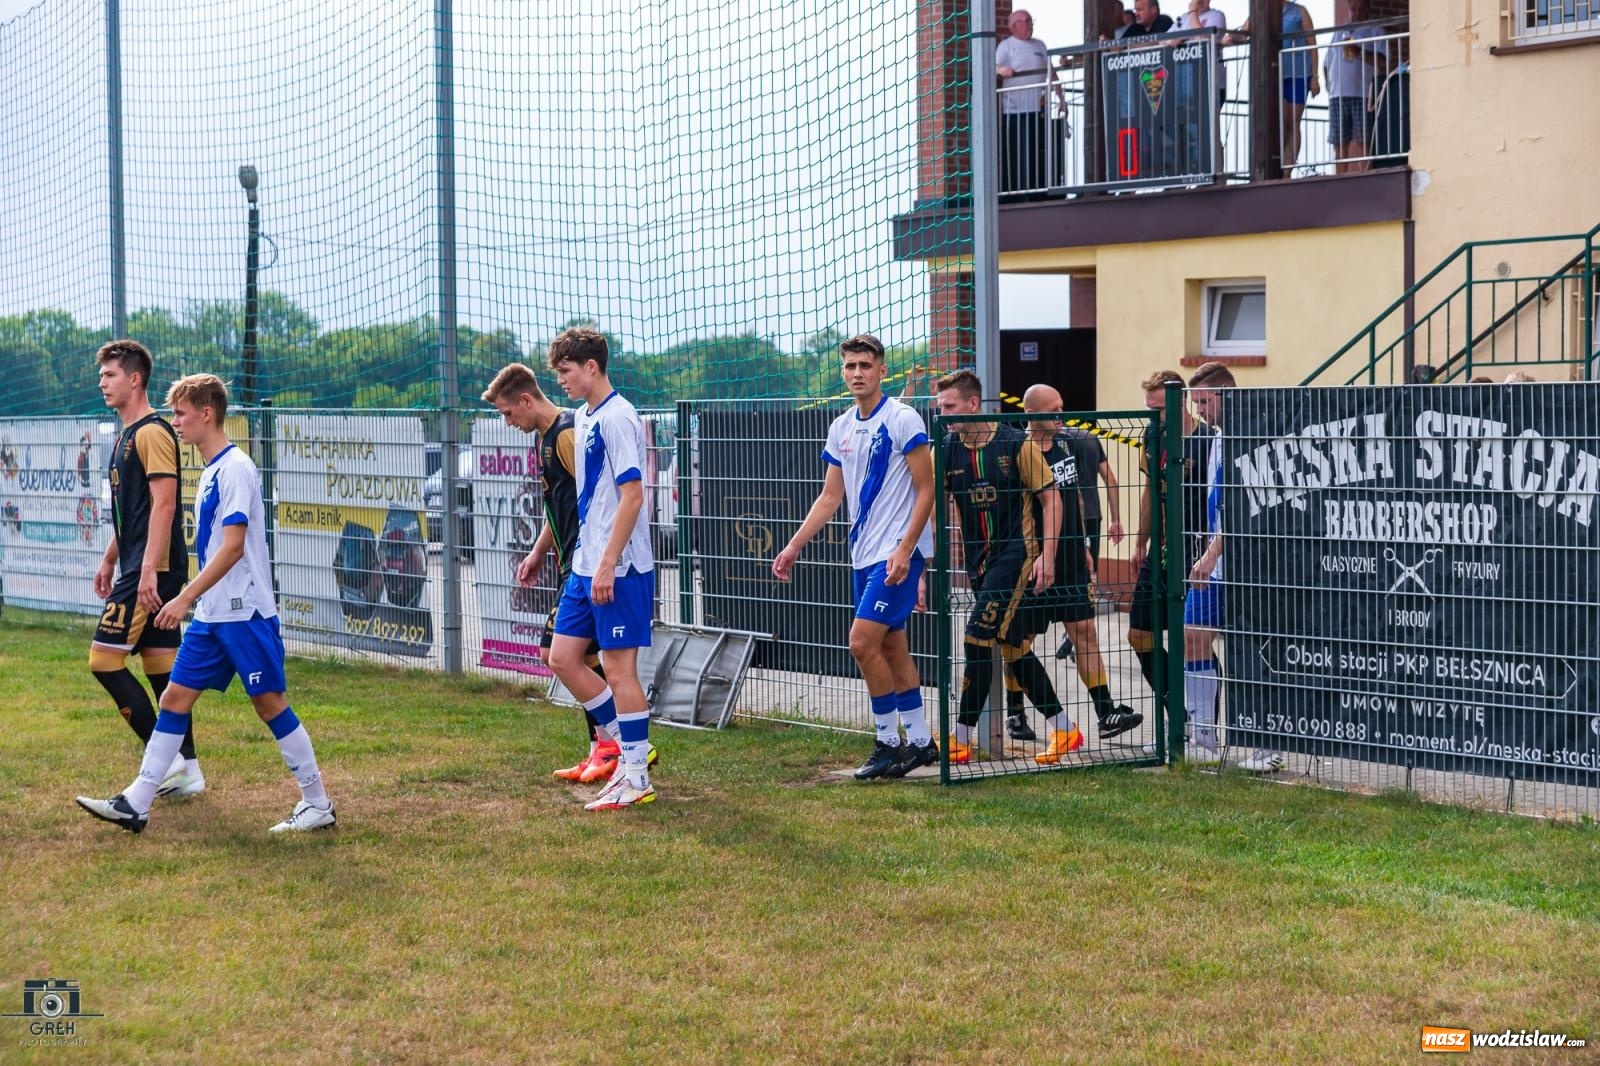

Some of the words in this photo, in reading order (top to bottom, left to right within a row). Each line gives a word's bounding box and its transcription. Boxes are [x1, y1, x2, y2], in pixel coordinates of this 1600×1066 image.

[1107, 50, 1161, 71] GOSPODARZE
[480, 446, 523, 476] salon
[1234, 411, 1394, 518] MĘSKA
[1415, 410, 1600, 527] STACJA
[1324, 499, 1498, 546] BARBERSHOP
[1320, 555, 1377, 575] KLASYCZNE
[1452, 560, 1501, 581] FRYZURY
[101, 602, 127, 629] 21
[1388, 609, 1392, 626] I
[1395, 609, 1431, 628] BRODY
[511, 621, 544, 640] Gorzyc
[1285, 644, 1333, 669] Obok
[1339, 650, 1387, 678] stacji
[1393, 653, 1430, 677] PKP
[1436, 656, 1545, 687] BEŁSZNICA
[1238, 712, 1261, 730] tel.
[1267, 713, 1293, 733] 576
[1298, 716, 1331, 738] 090
[1335, 719, 1367, 741] 888
[1411, 700, 1485, 728] WIZYTĘ
